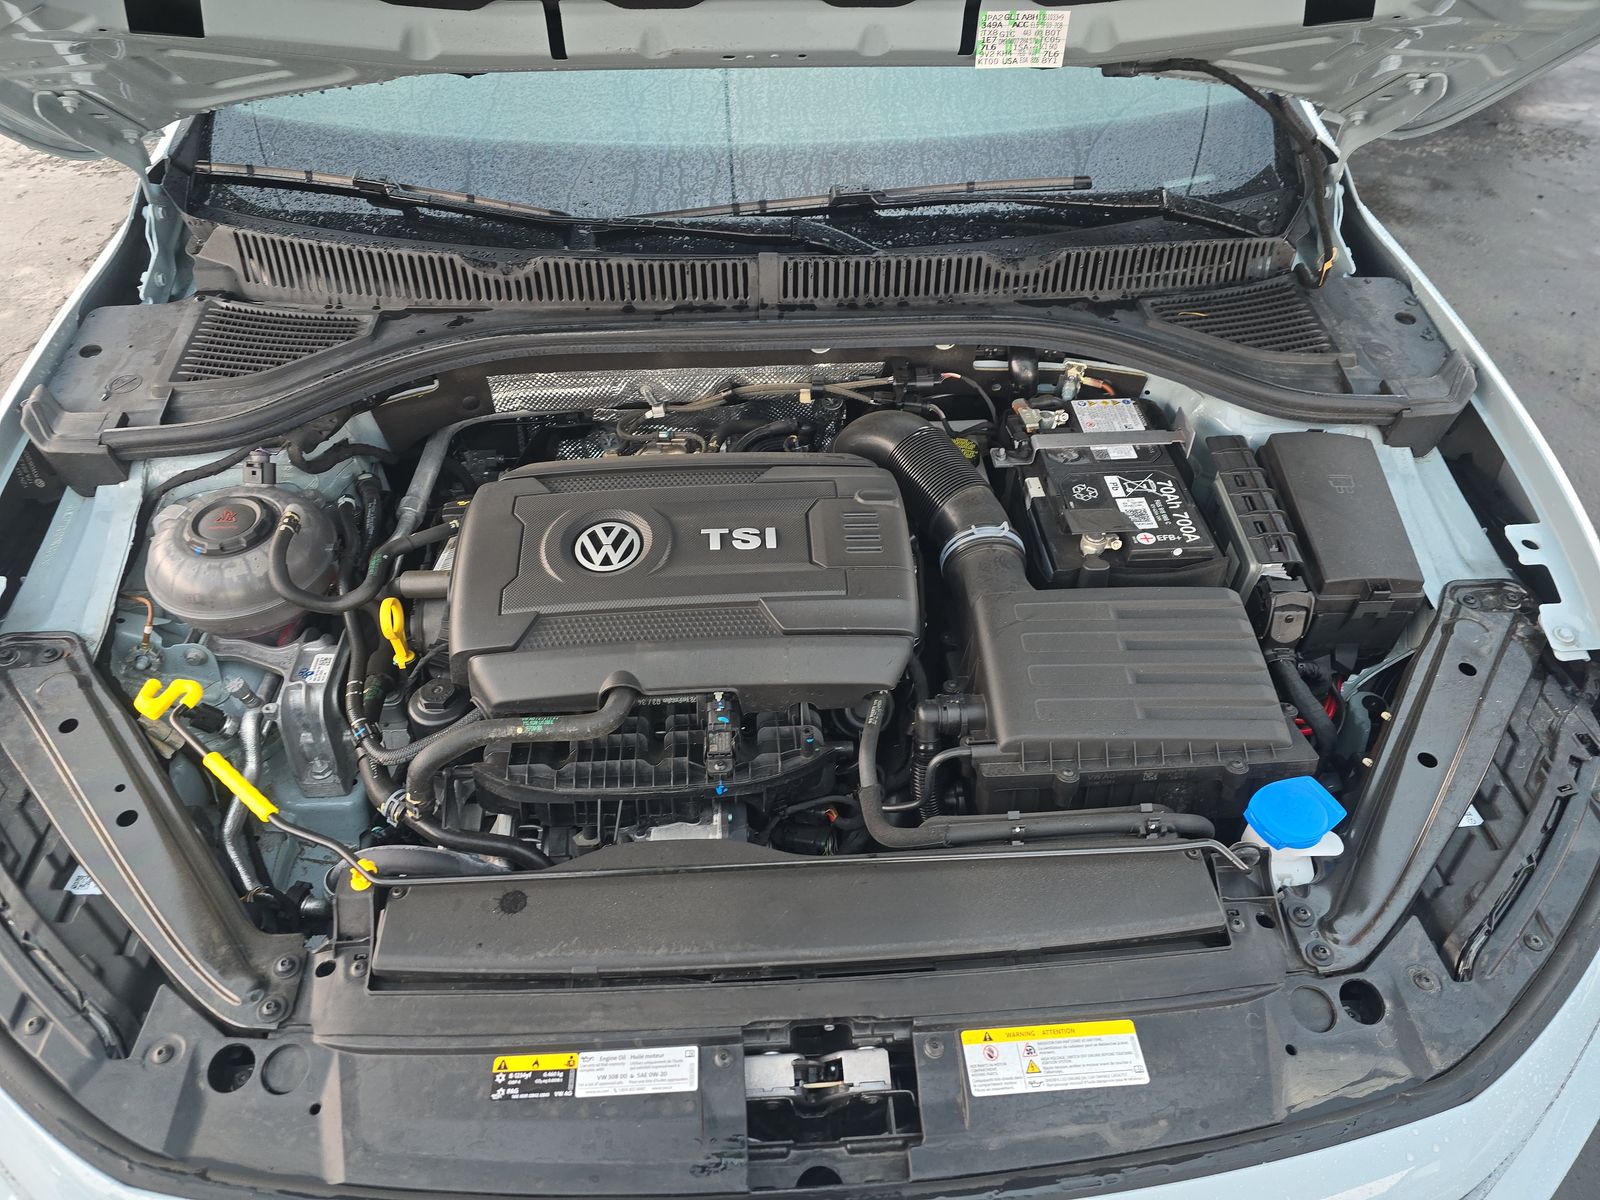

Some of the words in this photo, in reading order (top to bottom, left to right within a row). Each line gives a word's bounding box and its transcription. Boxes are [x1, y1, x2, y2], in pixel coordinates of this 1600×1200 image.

[981, 21, 1003, 29] 349A
[1002, 57, 1019, 65] USA
[1043, 50, 1060, 58] 7L6
[1156, 480, 1183, 509] 70Ah
[1172, 511, 1201, 543] 700A
[575, 521, 641, 572] VW
[700, 527, 777, 551] TSI
